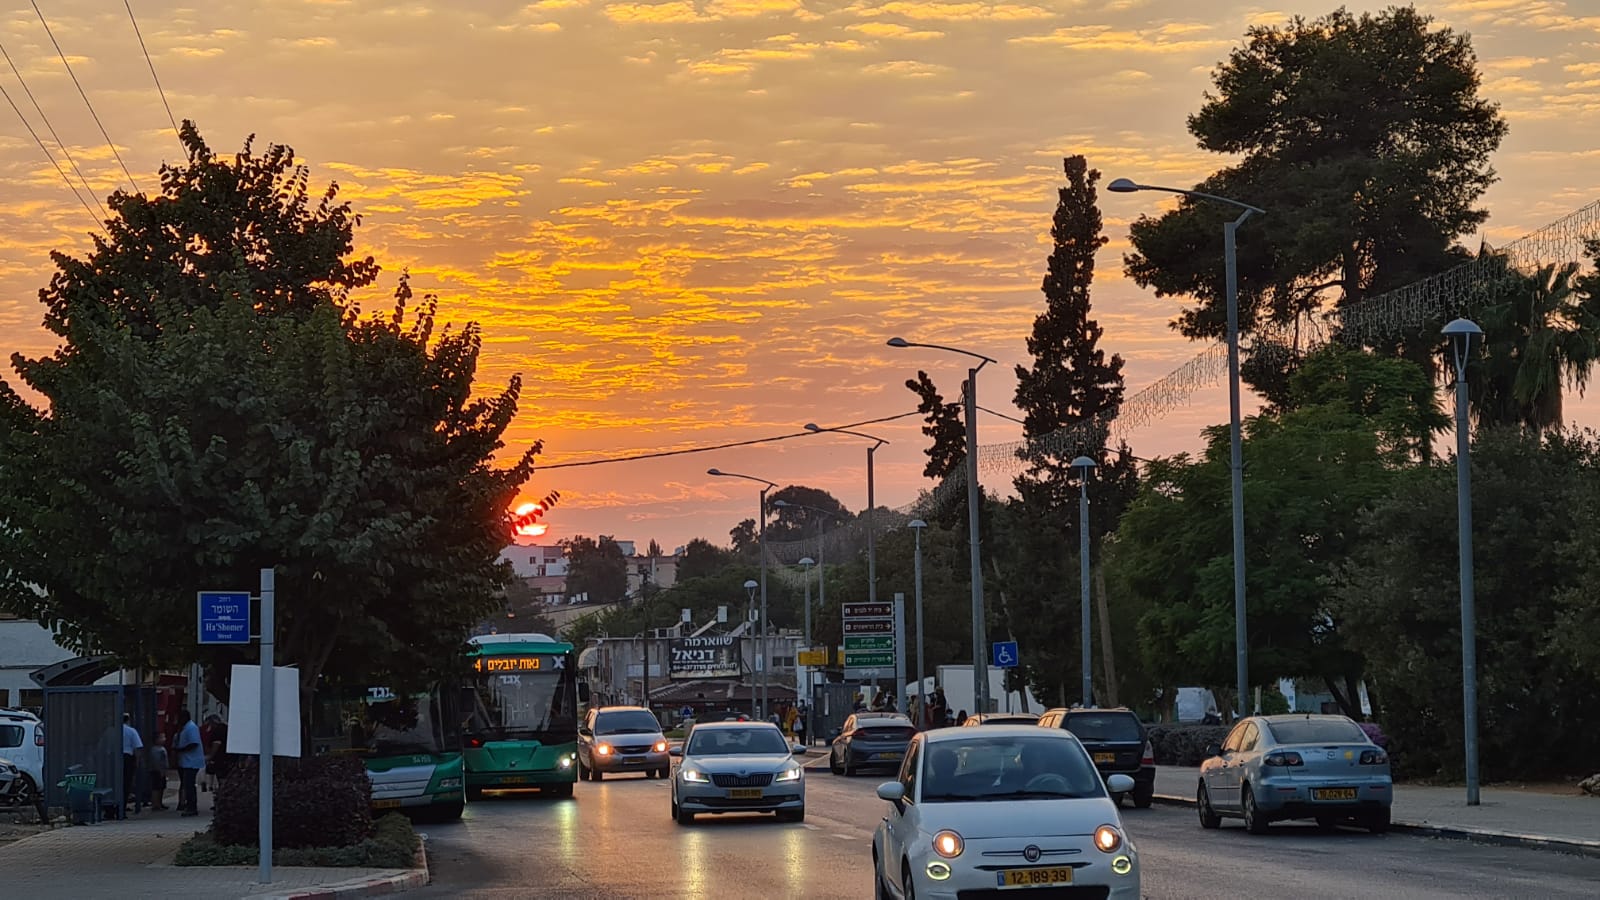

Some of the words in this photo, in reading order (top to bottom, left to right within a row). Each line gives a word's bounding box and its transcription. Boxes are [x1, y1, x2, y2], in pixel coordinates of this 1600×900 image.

[211, 605, 239, 614] השומר
[684, 635, 733, 647] שווארמה
[672, 647, 715, 660] דניאל
[519, 658, 540, 670] נאות
